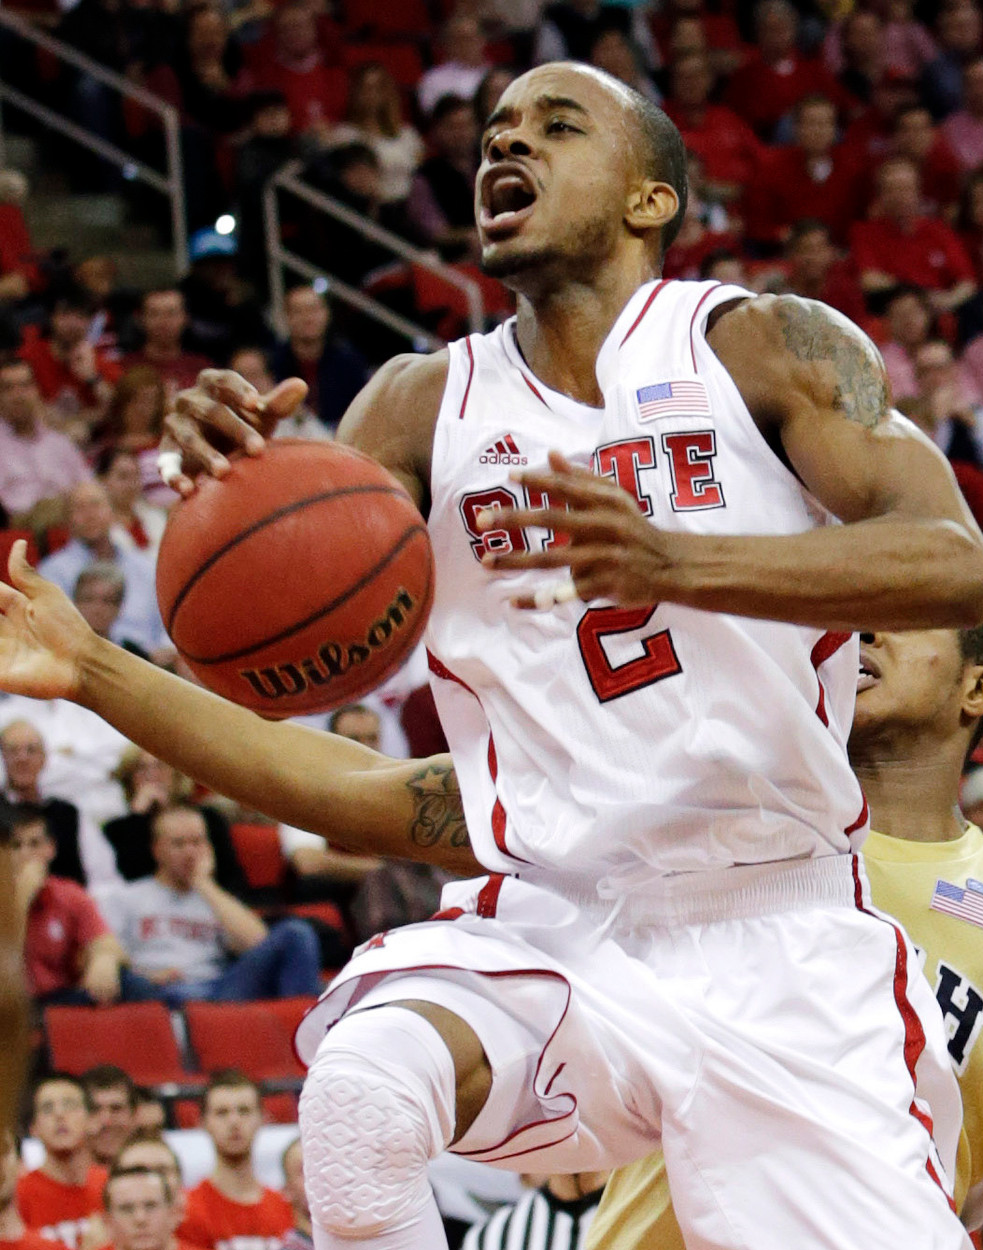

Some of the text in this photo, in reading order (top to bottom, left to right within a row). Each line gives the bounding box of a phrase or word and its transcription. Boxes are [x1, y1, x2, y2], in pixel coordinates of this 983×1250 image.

[459, 429, 727, 563] STTE
[478, 452, 528, 465] adidas
[240, 587, 413, 699] Wilson
[576, 600, 683, 704] 2
